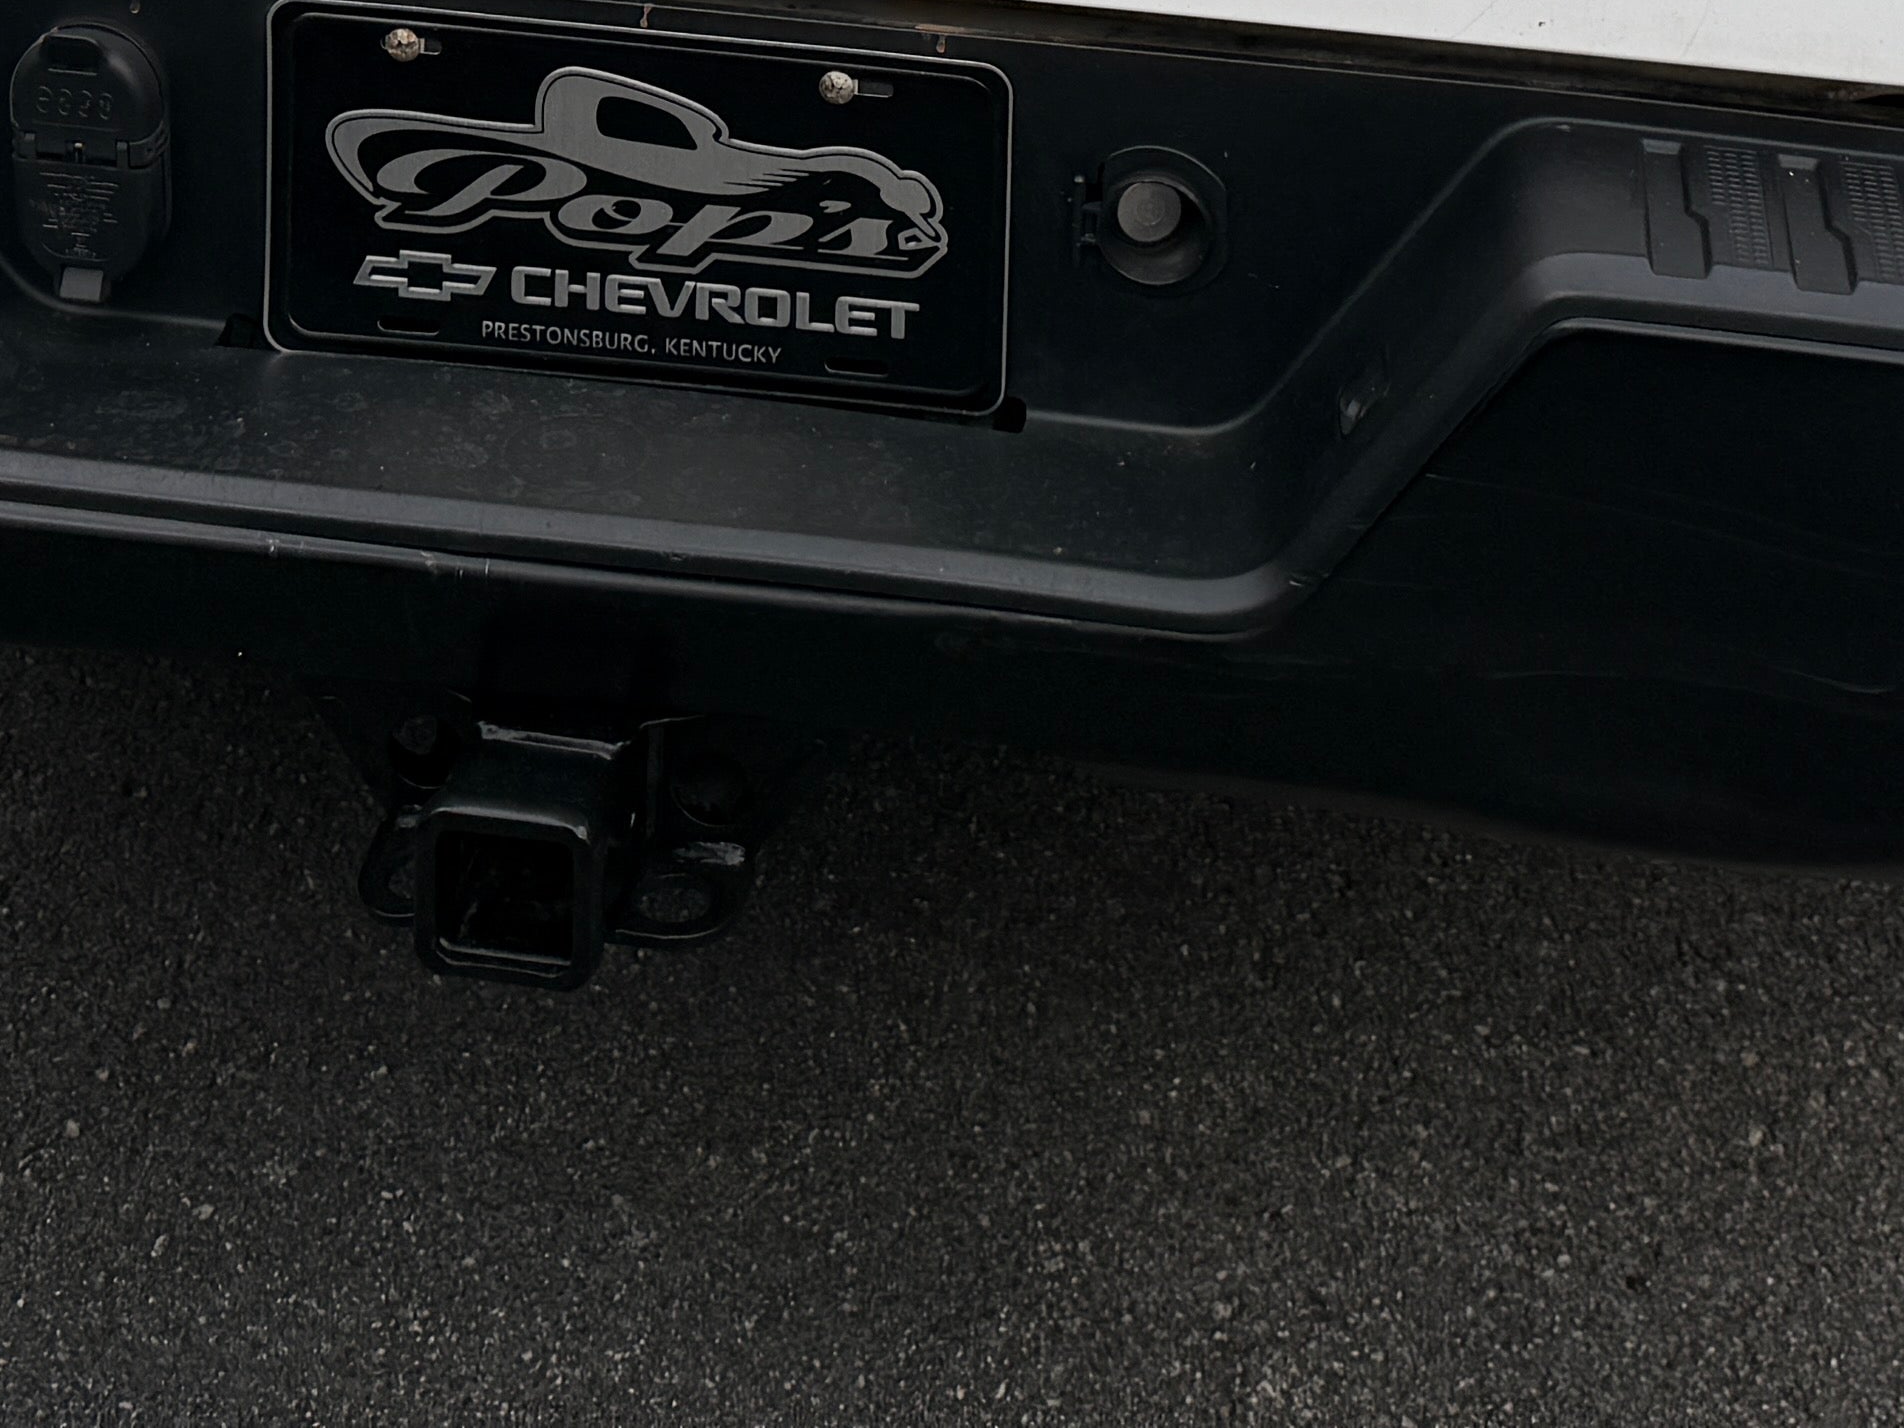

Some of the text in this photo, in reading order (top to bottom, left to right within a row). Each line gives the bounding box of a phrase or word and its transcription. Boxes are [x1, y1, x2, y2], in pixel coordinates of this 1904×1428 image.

[376, 147, 912, 259] Pop's
[510, 264, 921, 340] CHEVROLET
[480, 319, 783, 365] PRESTONSBURG, KENTUCKY
